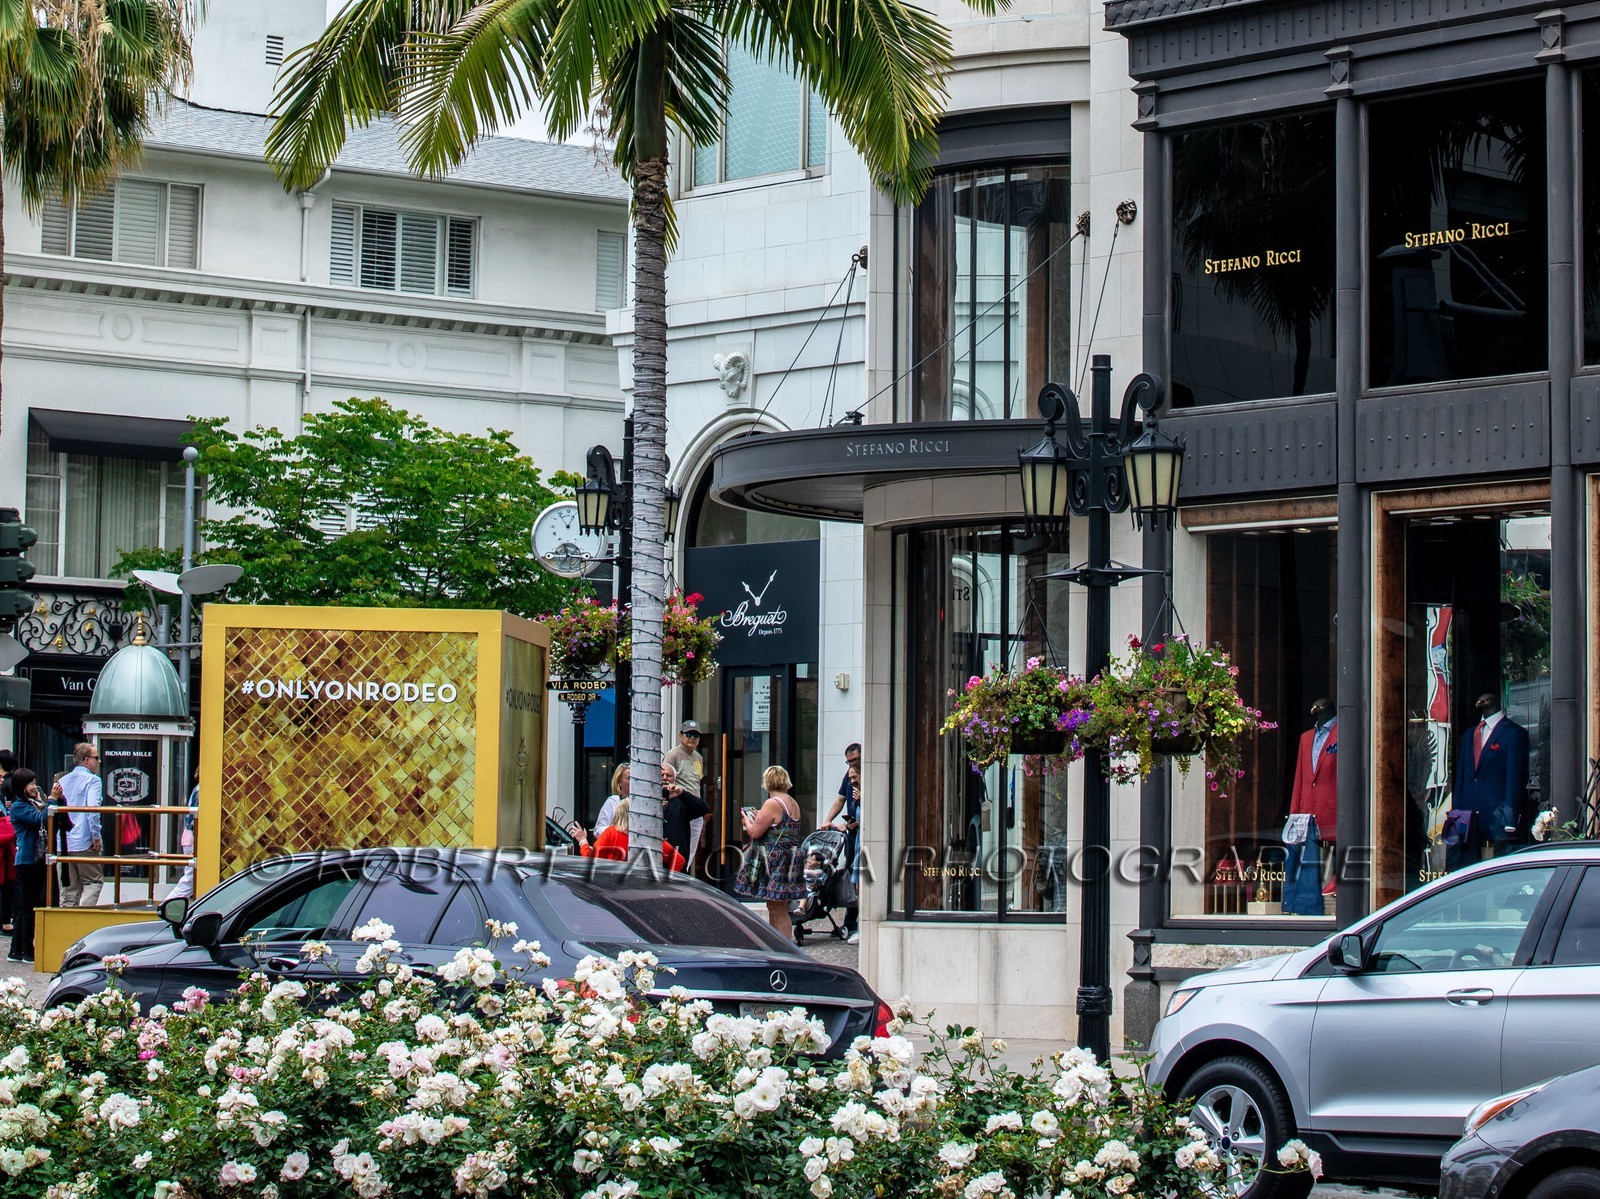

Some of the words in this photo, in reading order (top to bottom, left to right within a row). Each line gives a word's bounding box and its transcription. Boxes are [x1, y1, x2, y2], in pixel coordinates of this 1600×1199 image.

[1404, 228, 1465, 248] STEFANO
[1471, 222, 1509, 240] RICCI
[1204, 255, 1261, 274] STEFANO
[1266, 249, 1301, 266] RICCI
[846, 442, 905, 457] STEFANO
[909, 438, 950, 453] RICCI
[720, 599, 787, 637] Breguet
[61, 676, 84, 691] Van
[241, 678, 458, 703] #ONLYONRODEO
[551, 681, 569, 690] VIA
[573, 681, 607, 690] RODEO
[112, 722, 136, 730] RODEO
[1260, 868, 1287, 882] RICCI
